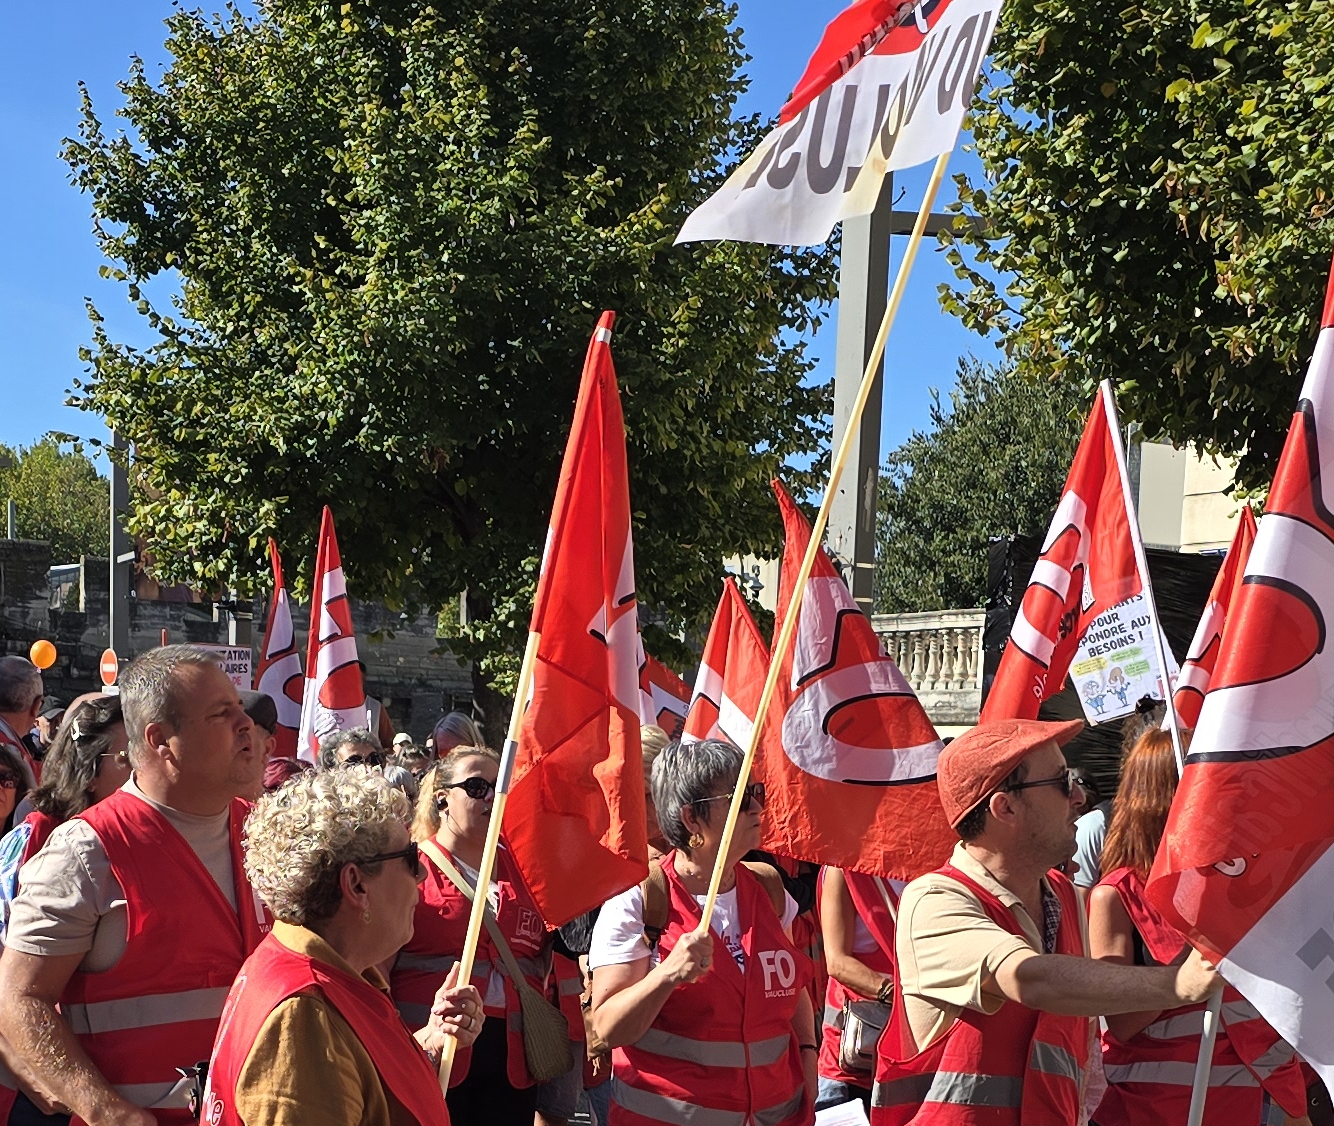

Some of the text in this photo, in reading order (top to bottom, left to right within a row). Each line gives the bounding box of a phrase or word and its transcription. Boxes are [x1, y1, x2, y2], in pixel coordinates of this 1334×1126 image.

[1089, 612, 1120, 631] POUR
[1088, 633, 1136, 658] BESOINS
[758, 949, 797, 990] FO
